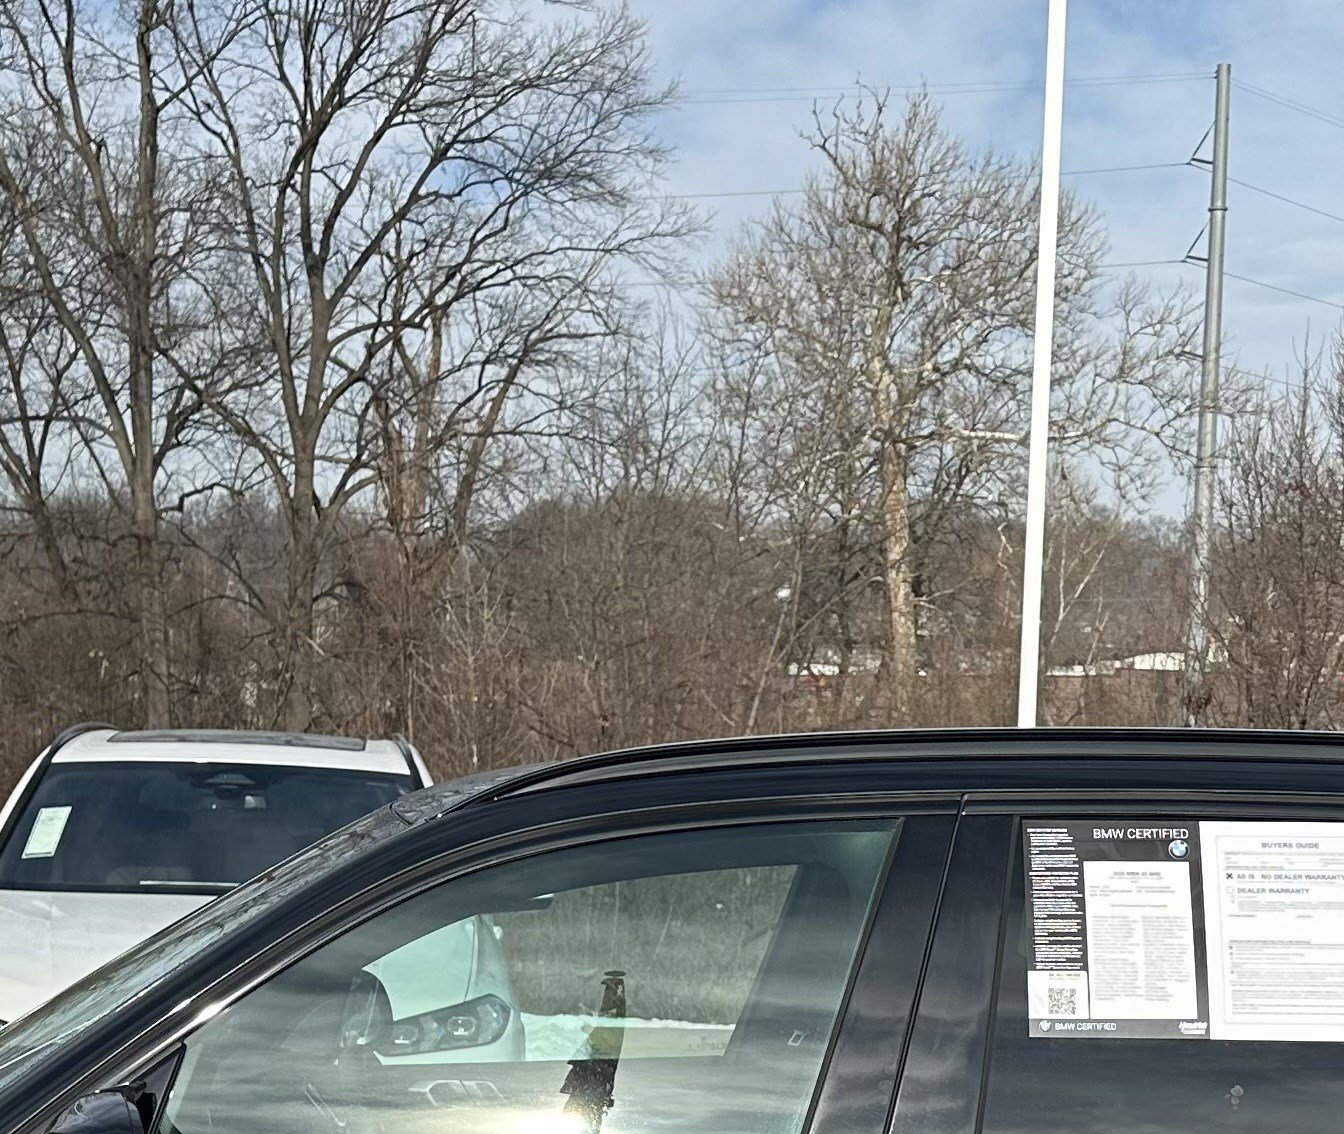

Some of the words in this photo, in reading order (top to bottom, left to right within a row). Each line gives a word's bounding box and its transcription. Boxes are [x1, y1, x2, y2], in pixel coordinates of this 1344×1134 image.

[1092, 828, 1124, 839] BMW
[1127, 828, 1189, 839] CERTIFIED
[1054, 1022, 1076, 1031] BMW
[1076, 1022, 1117, 1031] CERTIFIED
